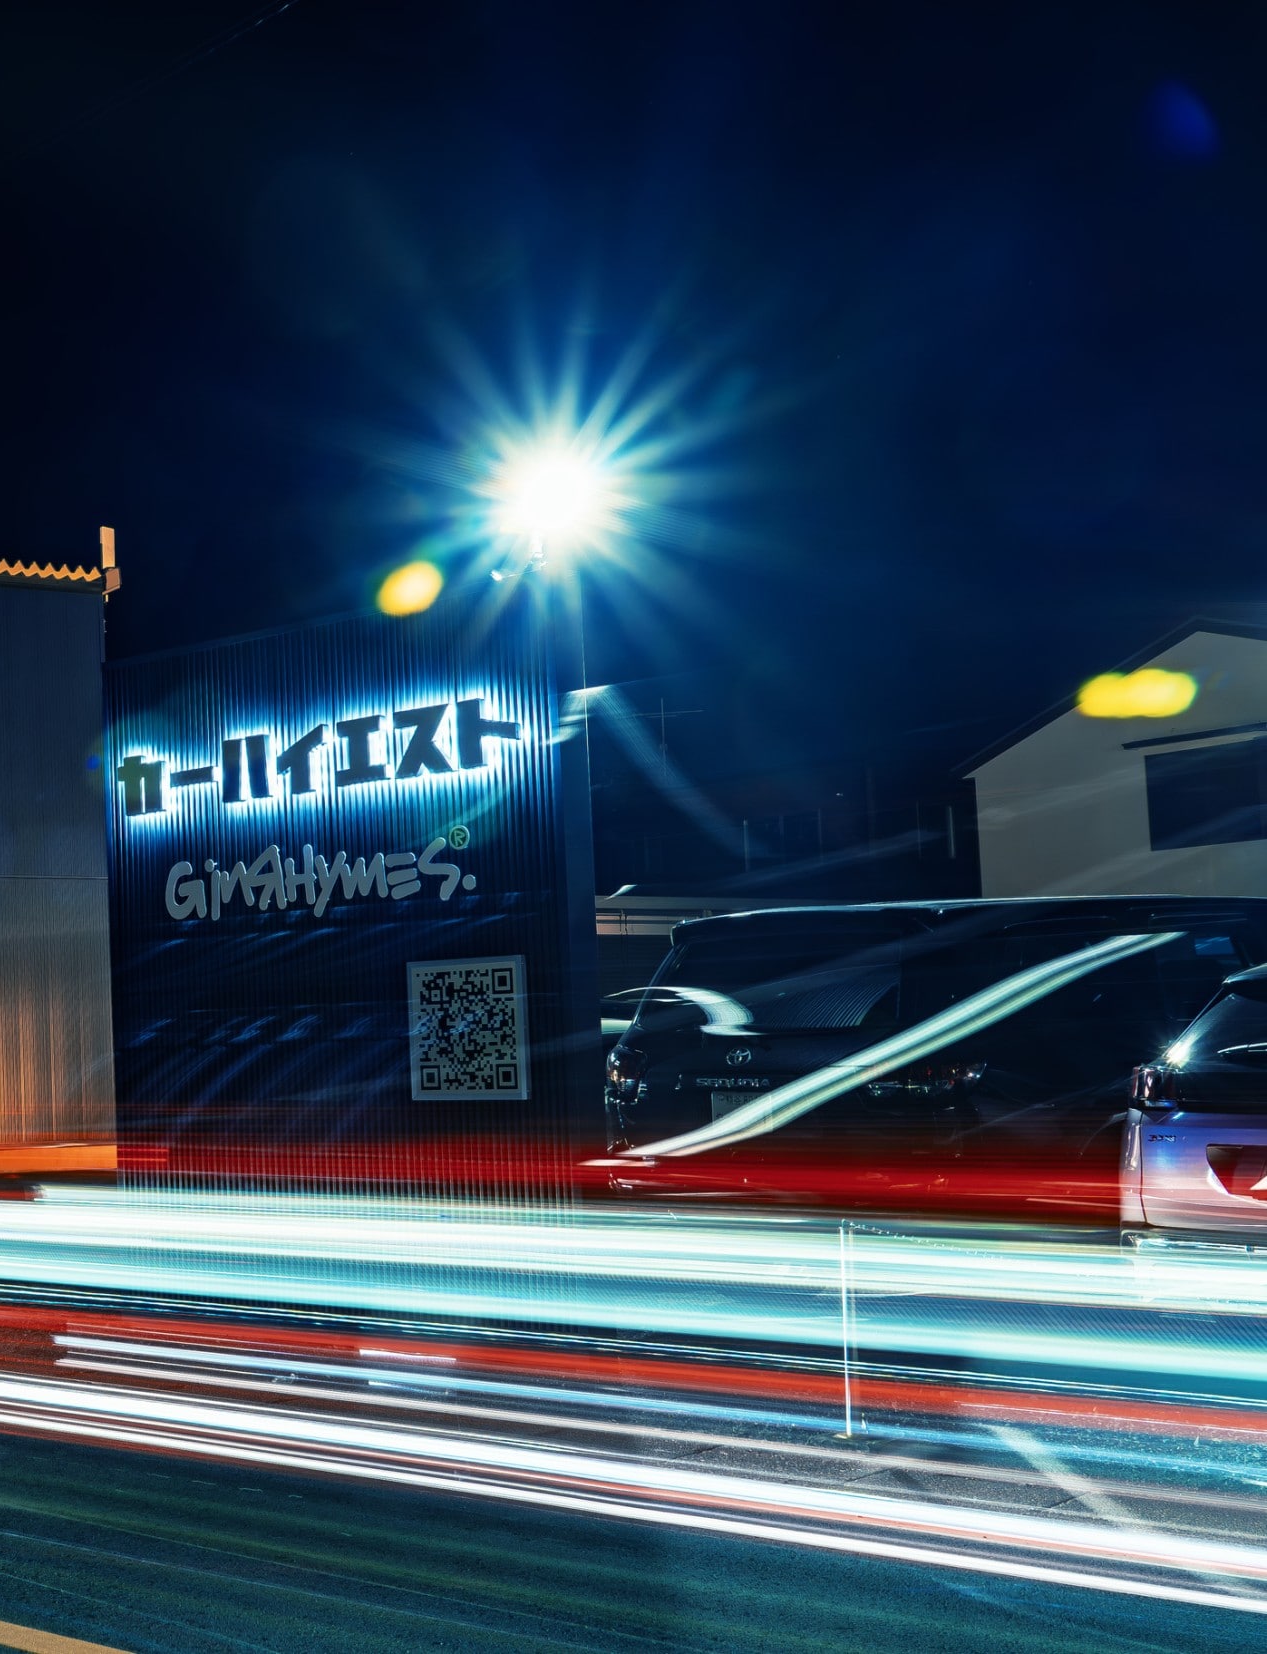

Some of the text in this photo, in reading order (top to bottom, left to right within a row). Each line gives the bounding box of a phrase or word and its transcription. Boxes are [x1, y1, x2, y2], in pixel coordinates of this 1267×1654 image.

[117, 697, 521, 817] カーハイエスト
[695, 1077, 771, 1088] SEQUOIA
